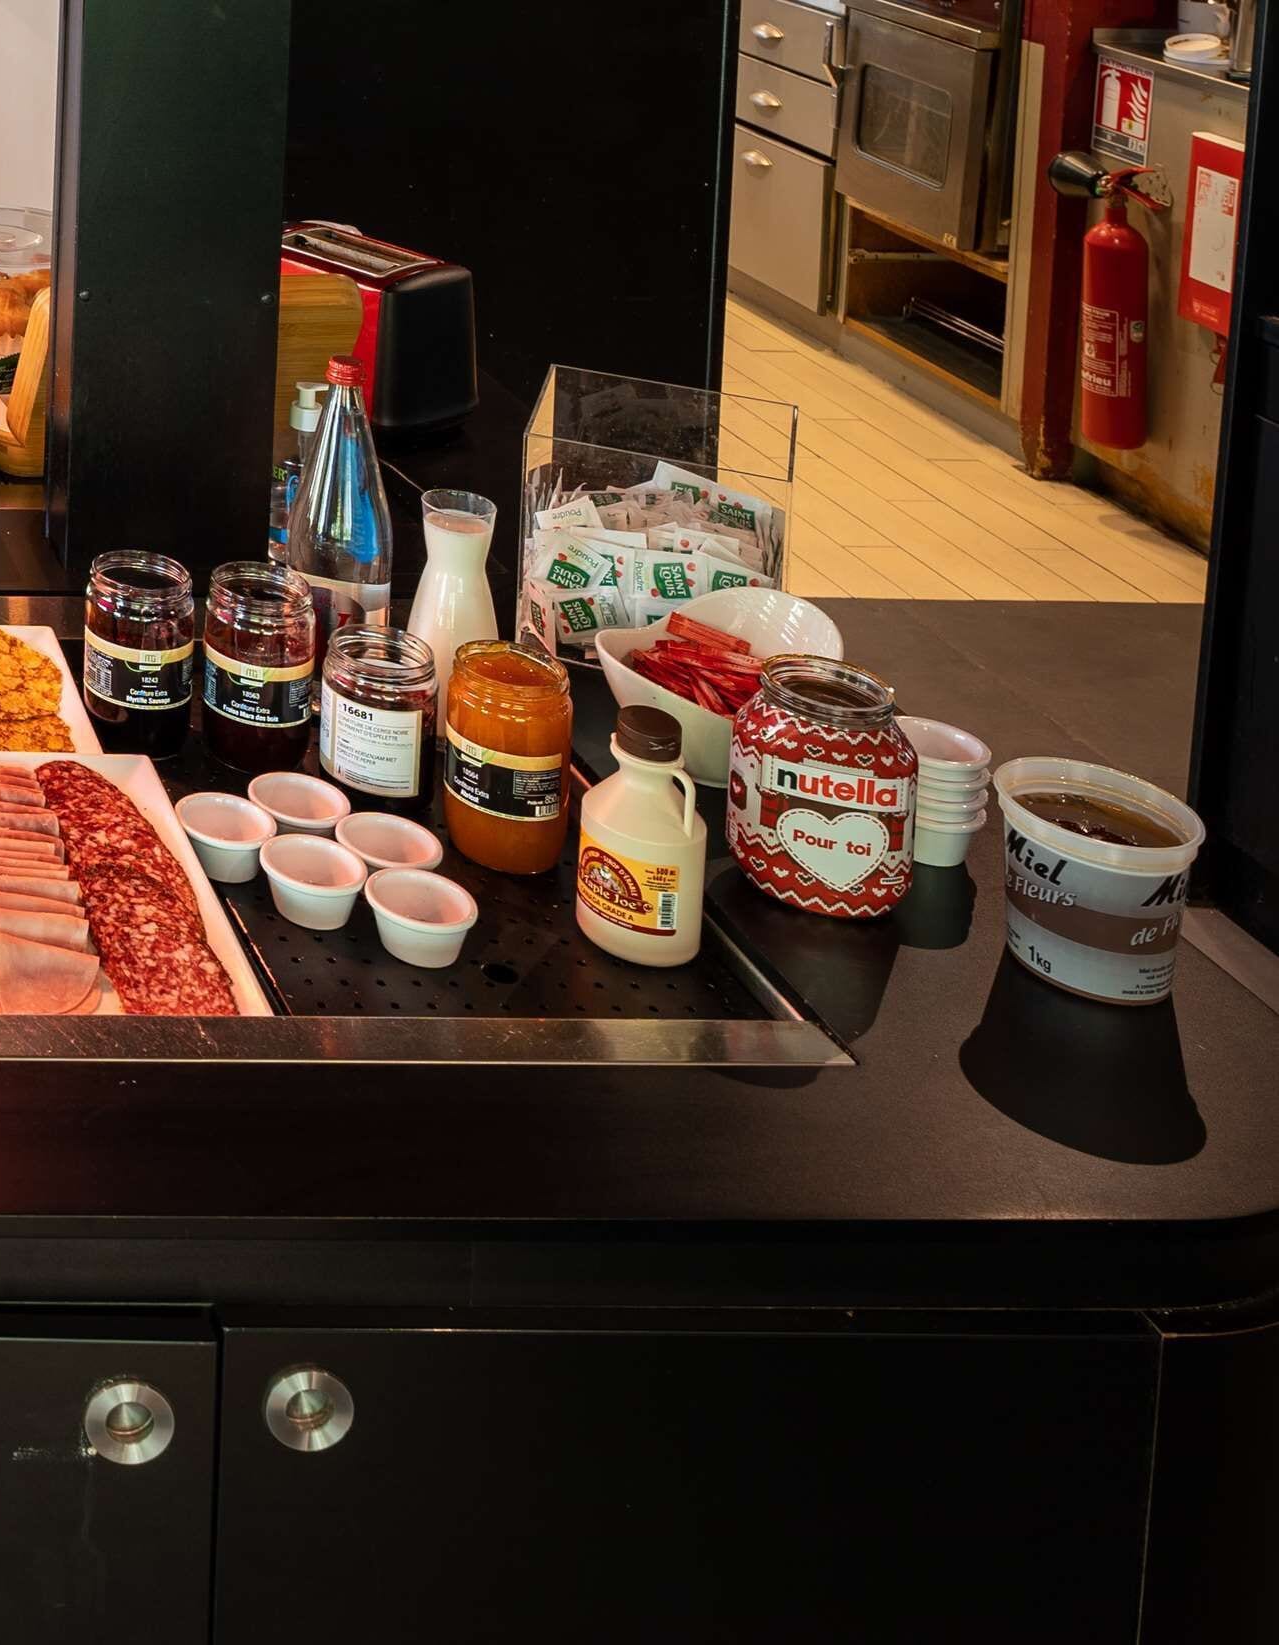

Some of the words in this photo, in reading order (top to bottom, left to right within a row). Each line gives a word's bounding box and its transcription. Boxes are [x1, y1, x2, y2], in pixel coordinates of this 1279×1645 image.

[552, 507, 582, 520] Poudre
[720, 505, 752, 521] SAINT
[567, 544, 599, 569] Poudre
[553, 565, 590, 587] LOUIS
[634, 561, 644, 592] Poudre
[660, 566, 676, 597] LOUIS
[672, 565, 687, 596] SAINT
[563, 602, 584, 630] SAINT
[573, 600, 591, 629] LOUIS
[129, 688, 155, 698] Confiture
[149, 698, 171, 706] Sauvage
[231, 700, 255, 713] Confiture
[256, 705, 271, 715] Extra
[343, 703, 373, 721] 16681
[363, 730, 399, 741] D'ESPELETTE
[453, 776, 475, 794] Confiture
[475, 788, 490, 800] Extra
[777, 768, 899, 807] nutella
[793, 828, 838, 850] Pour
[845, 840, 873, 857] toi
[1006, 828, 1068, 886] Miel
[613, 893, 638, 911] Joe
[1014, 876, 1077, 907] Fleurs
[601, 902, 627, 920] GRADE
[1129, 926, 1159, 946] de
[1028, 945, 1051, 974] 1kg
